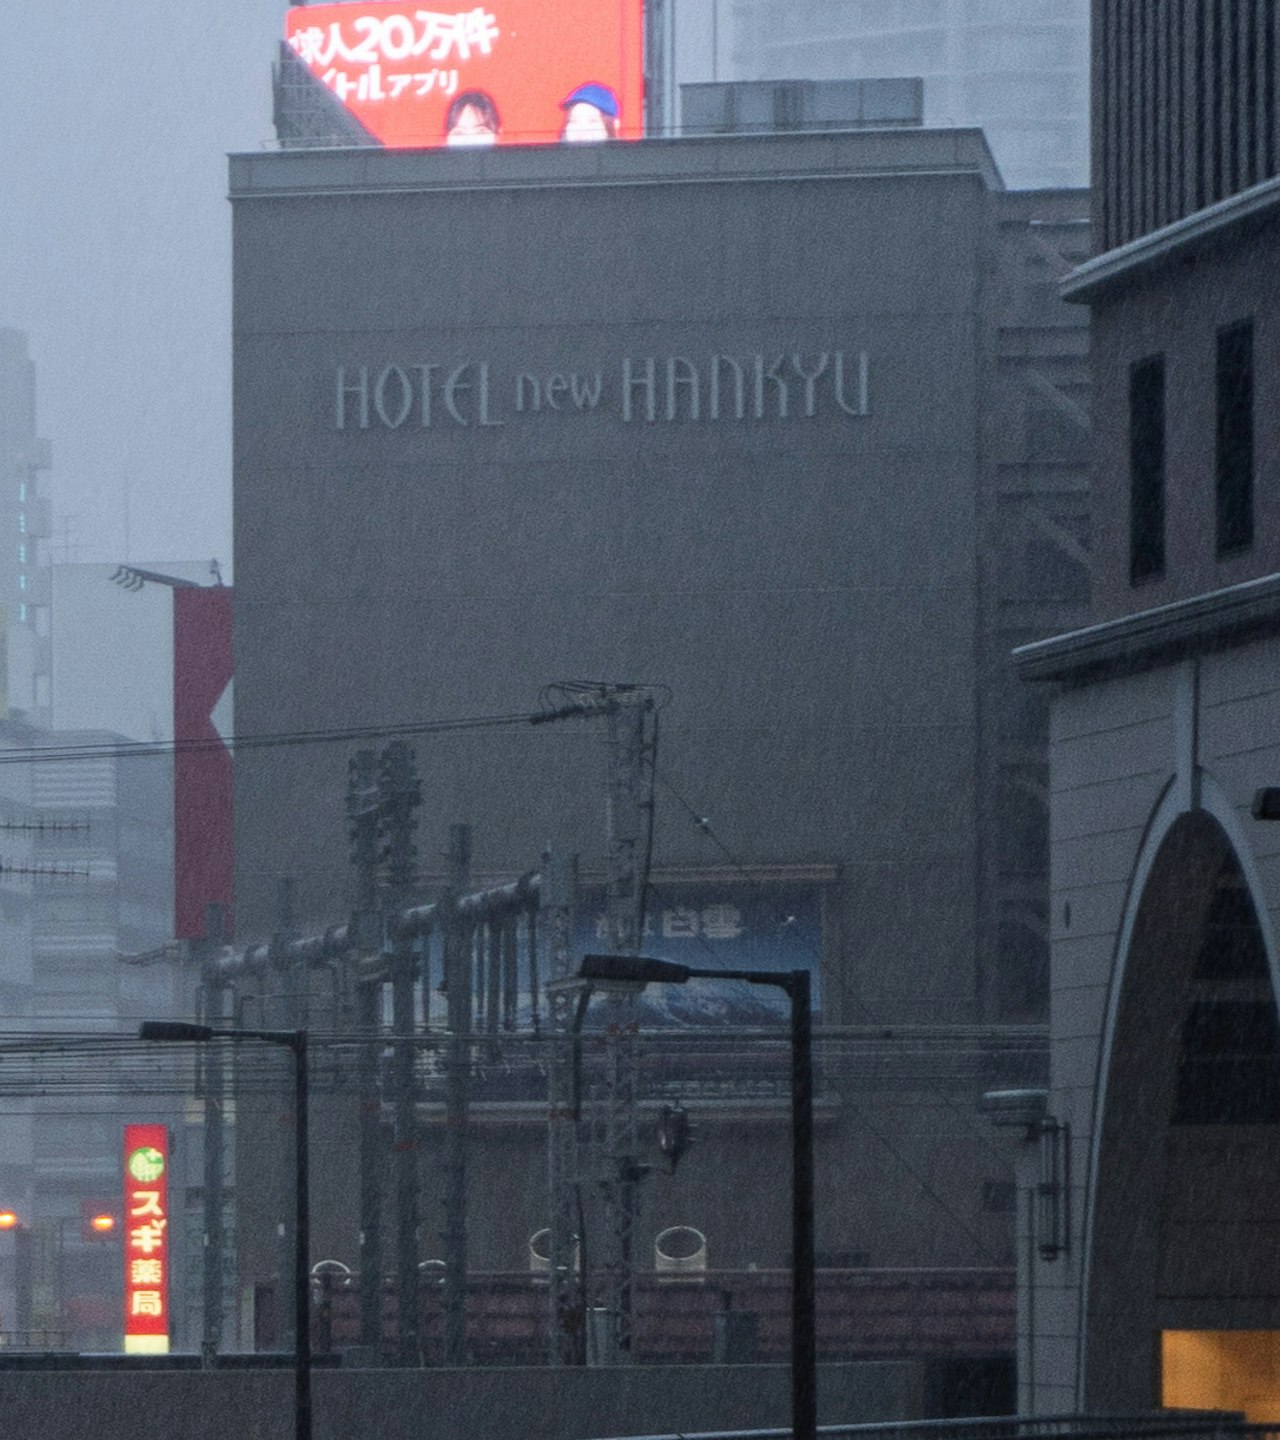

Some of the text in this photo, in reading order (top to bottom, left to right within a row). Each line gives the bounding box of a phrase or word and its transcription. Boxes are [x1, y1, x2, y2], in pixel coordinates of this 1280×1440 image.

[334, 350, 874, 430] HOTEL new HANKYU
[130, 1190, 167, 1317] スギ薬局
